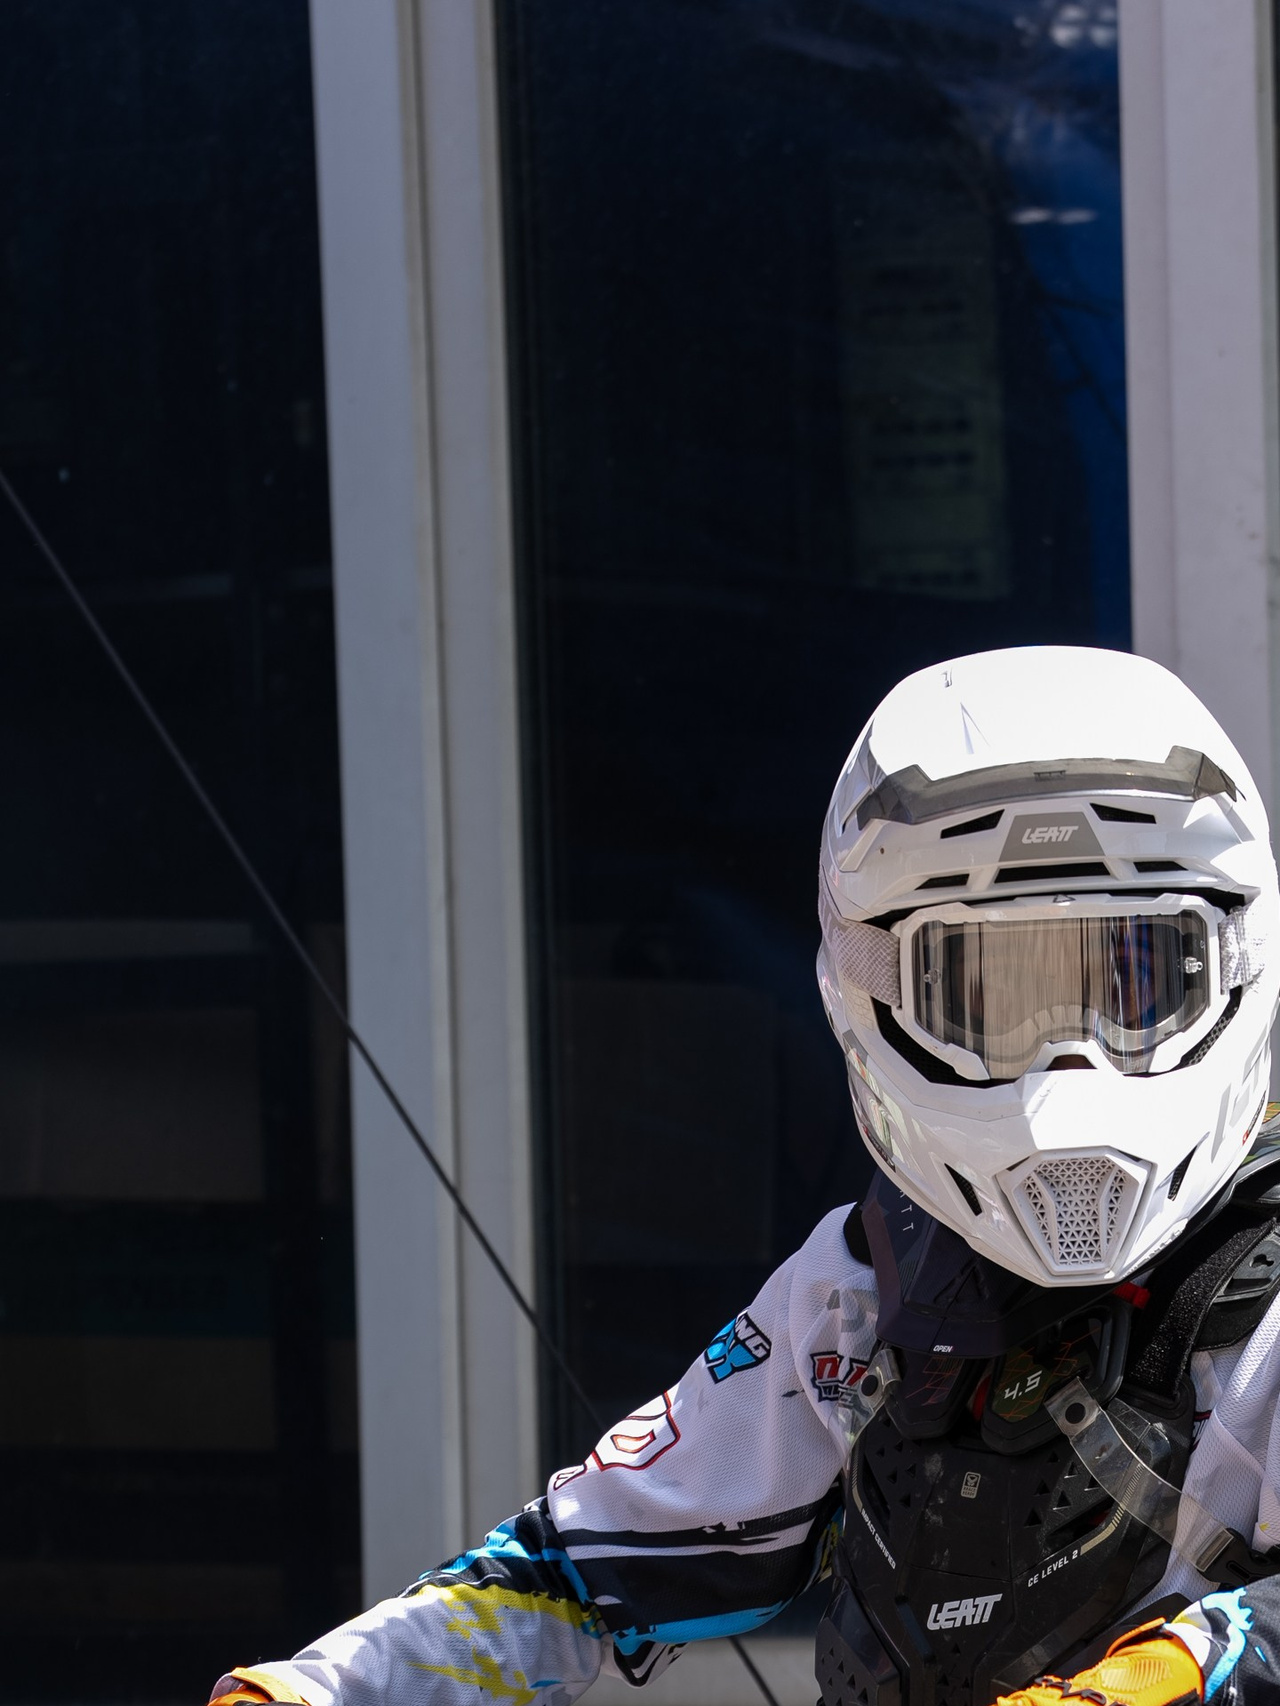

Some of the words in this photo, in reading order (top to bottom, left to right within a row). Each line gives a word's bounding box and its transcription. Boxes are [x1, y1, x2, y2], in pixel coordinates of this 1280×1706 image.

[1022, 826, 1079, 845] LEATT
[933, 1344, 953, 1353] OPEN
[1004, 1370, 1043, 1400] 4.5
[874, 1533, 896, 1569] CERTIFIED
[1028, 1573, 1040, 1588] CE
[1041, 1557, 1069, 1580] LEVEL
[1072, 1549, 1079, 1560] 2
[927, 1593, 1003, 1631] LEATT
